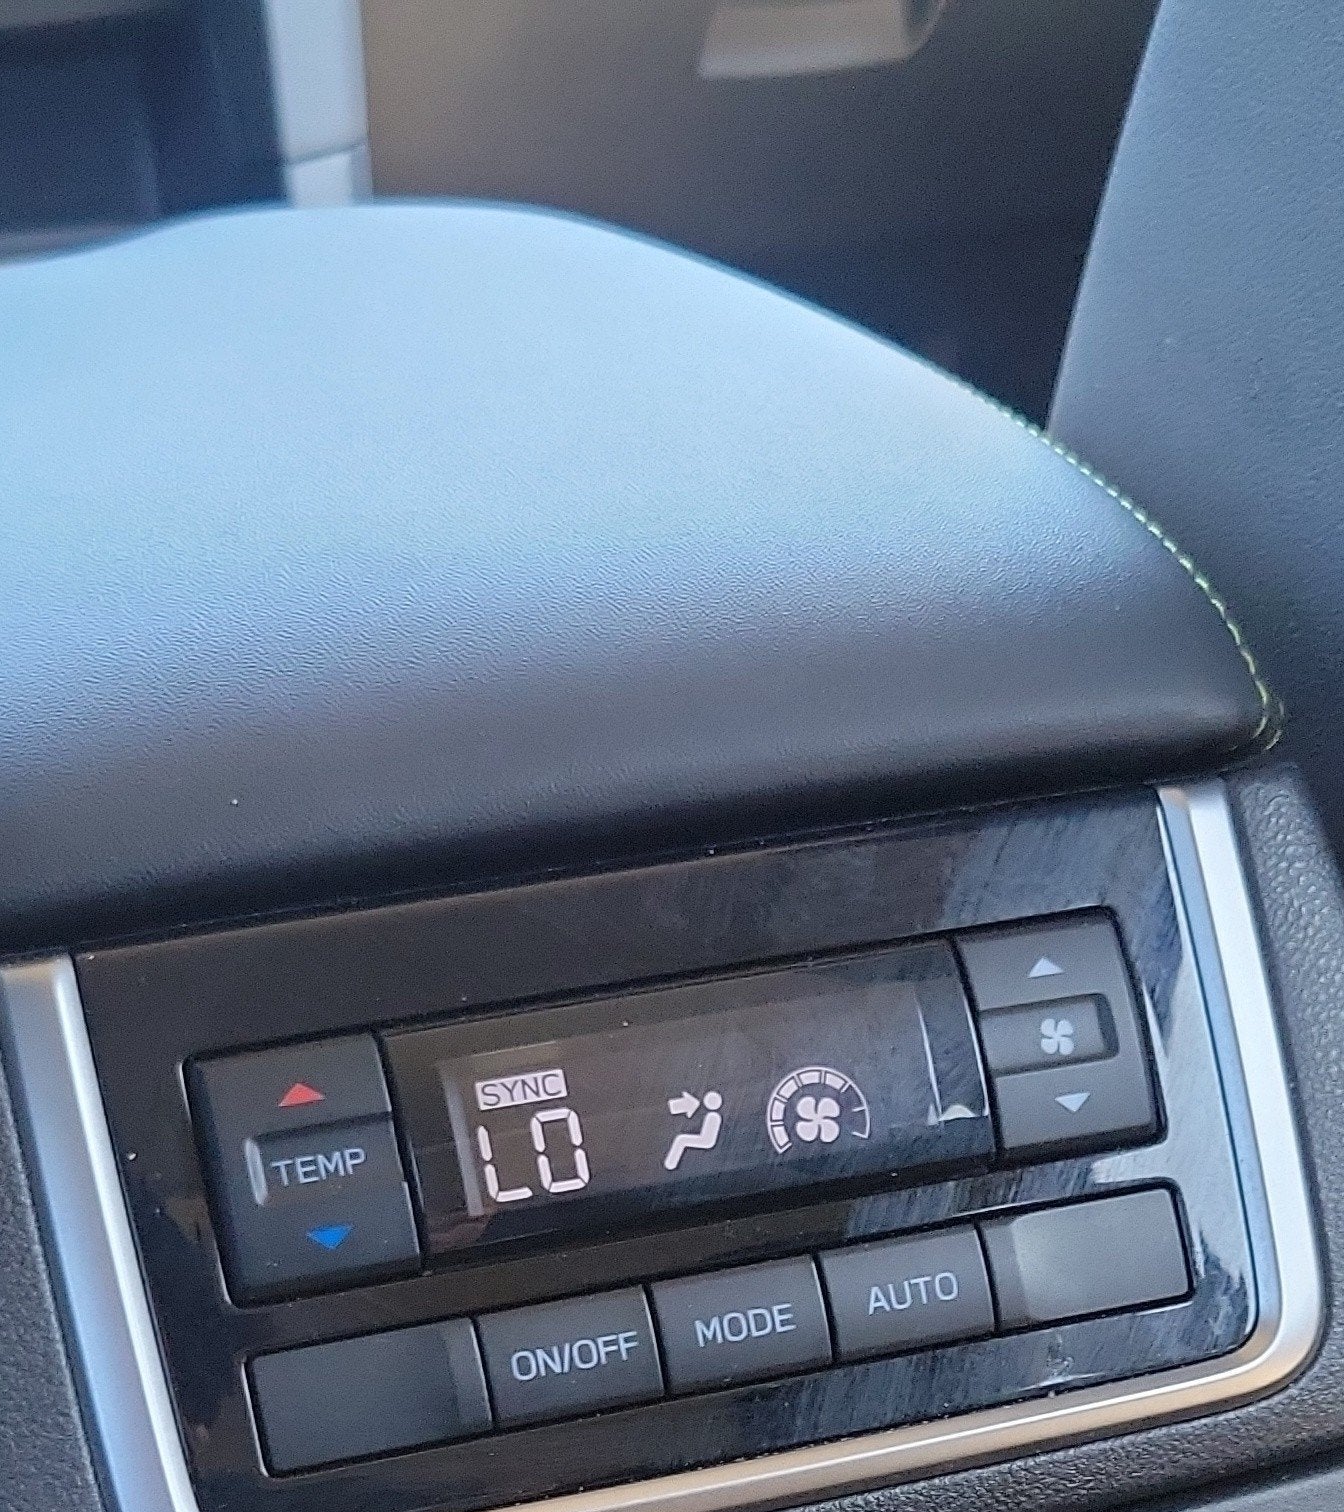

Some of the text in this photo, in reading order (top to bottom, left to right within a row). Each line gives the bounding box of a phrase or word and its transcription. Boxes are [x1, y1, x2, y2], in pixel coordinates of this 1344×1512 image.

[480, 1072, 563, 1107] SYNC
[270, 1147, 366, 1187] TEMP
[867, 1271, 959, 1317] AUTO
[693, 1303, 797, 1348] MODE
[509, 1330, 640, 1382] ON/OFF
